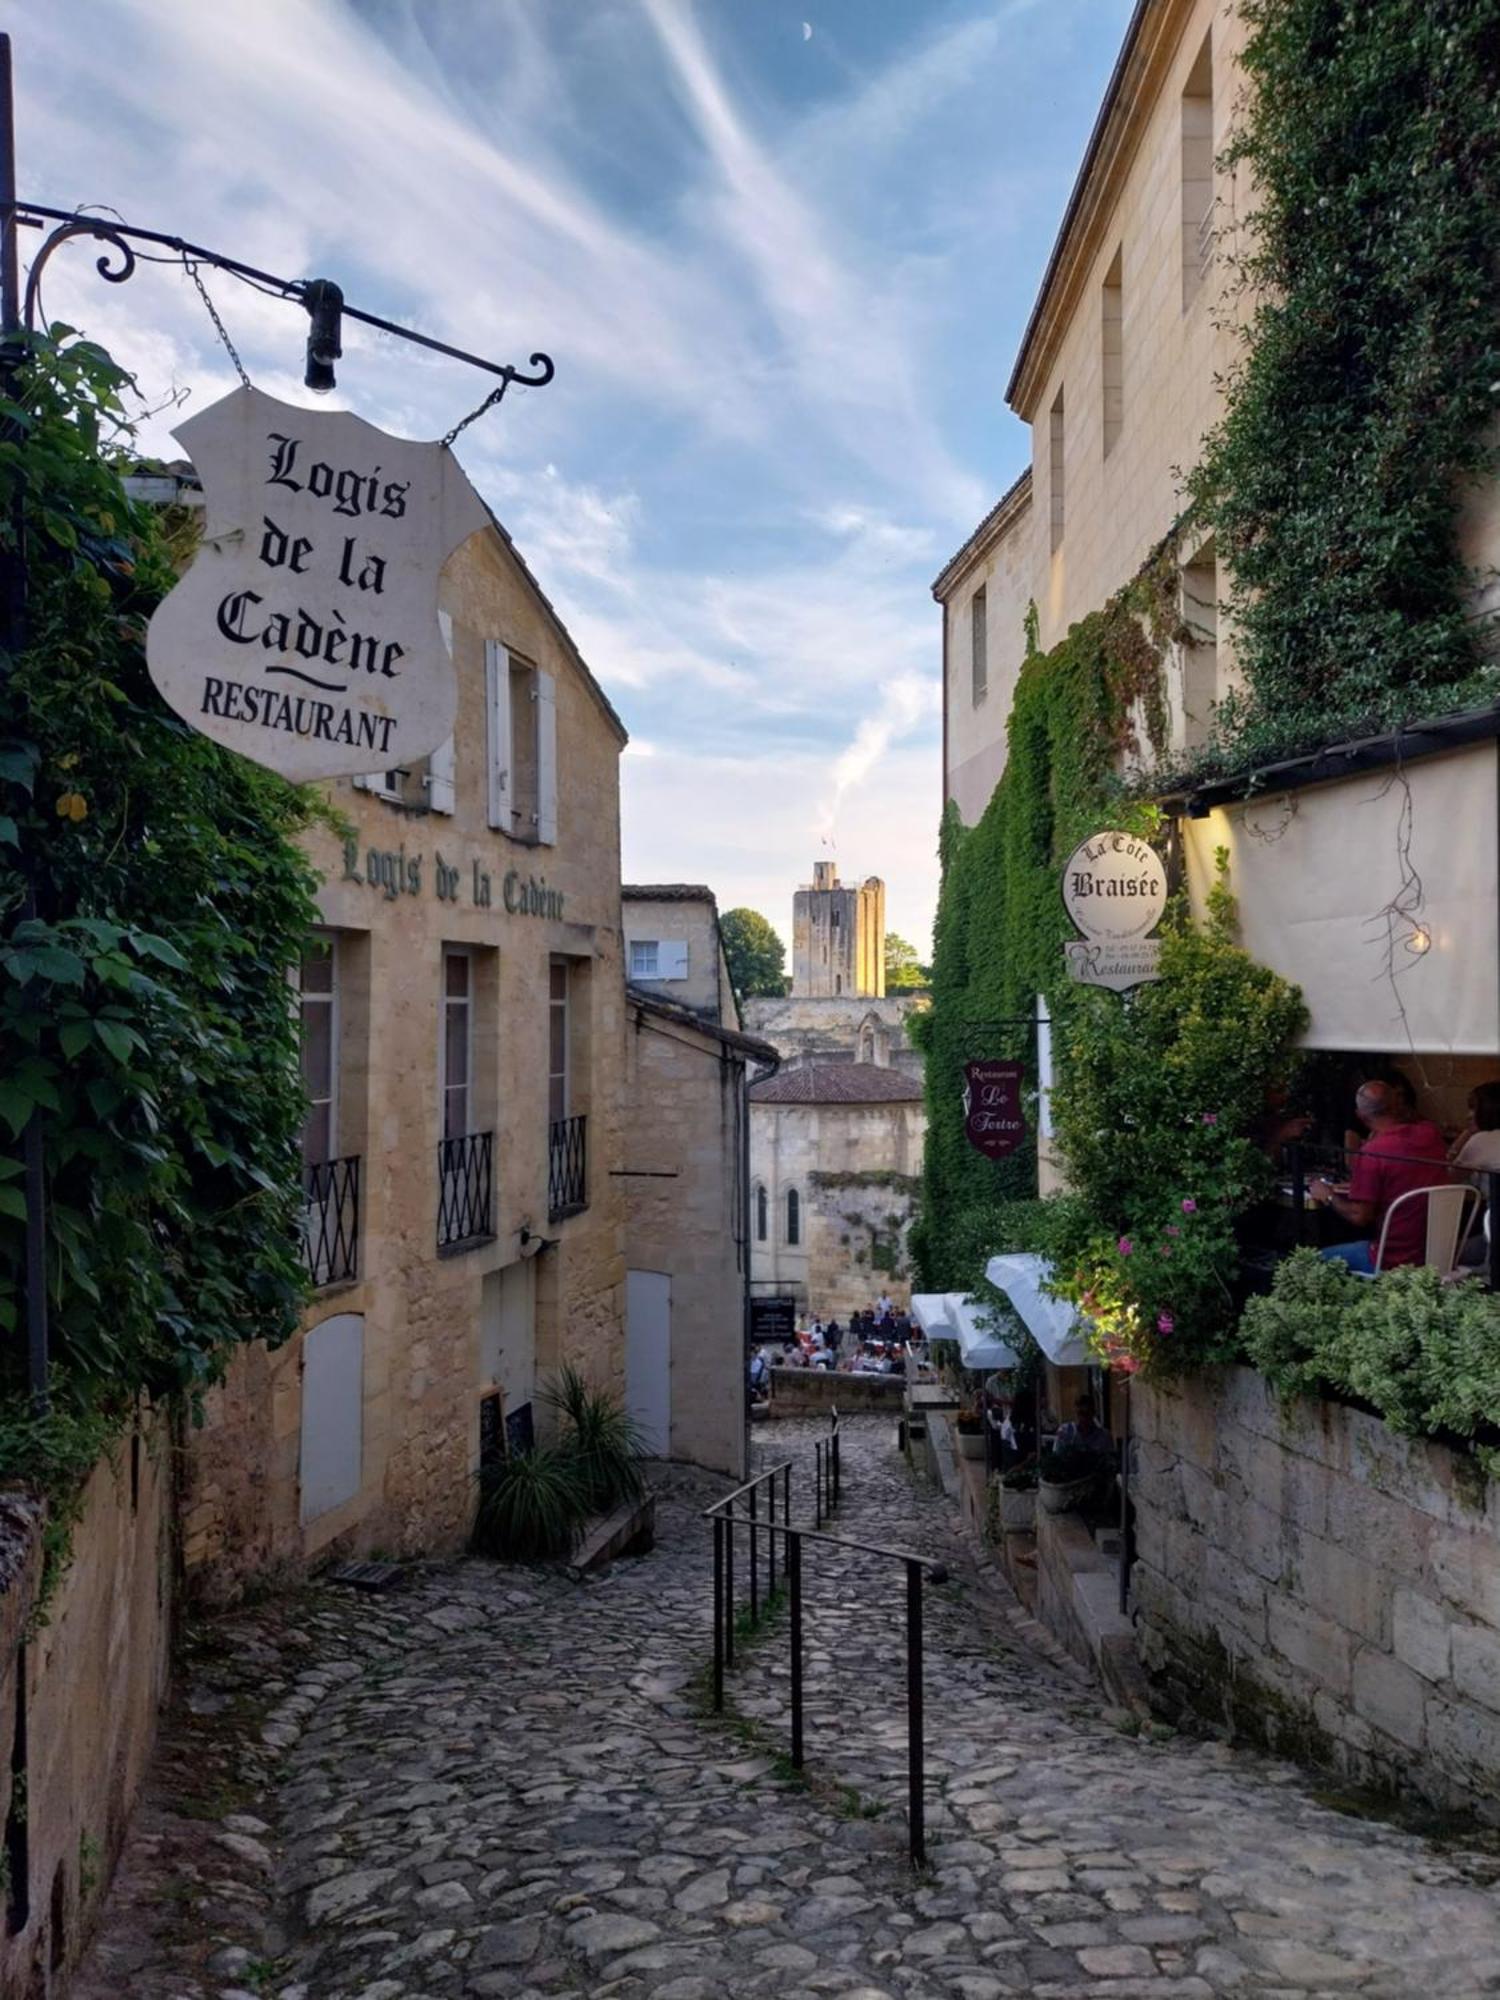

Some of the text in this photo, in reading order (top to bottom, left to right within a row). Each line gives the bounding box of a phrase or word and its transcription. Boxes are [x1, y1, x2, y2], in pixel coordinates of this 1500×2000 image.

[266, 433, 411, 518] Logis
[259, 516, 387, 595] de la
[216, 590, 405, 678] Cadène
[200, 677, 397, 752] RESTAURANT
[341, 838, 422, 902] Logis
[435, 850, 459, 903] de
[473, 858, 491, 908] la
[1071, 870, 1160, 901] Braisée
[1081, 842, 1106, 862] La
